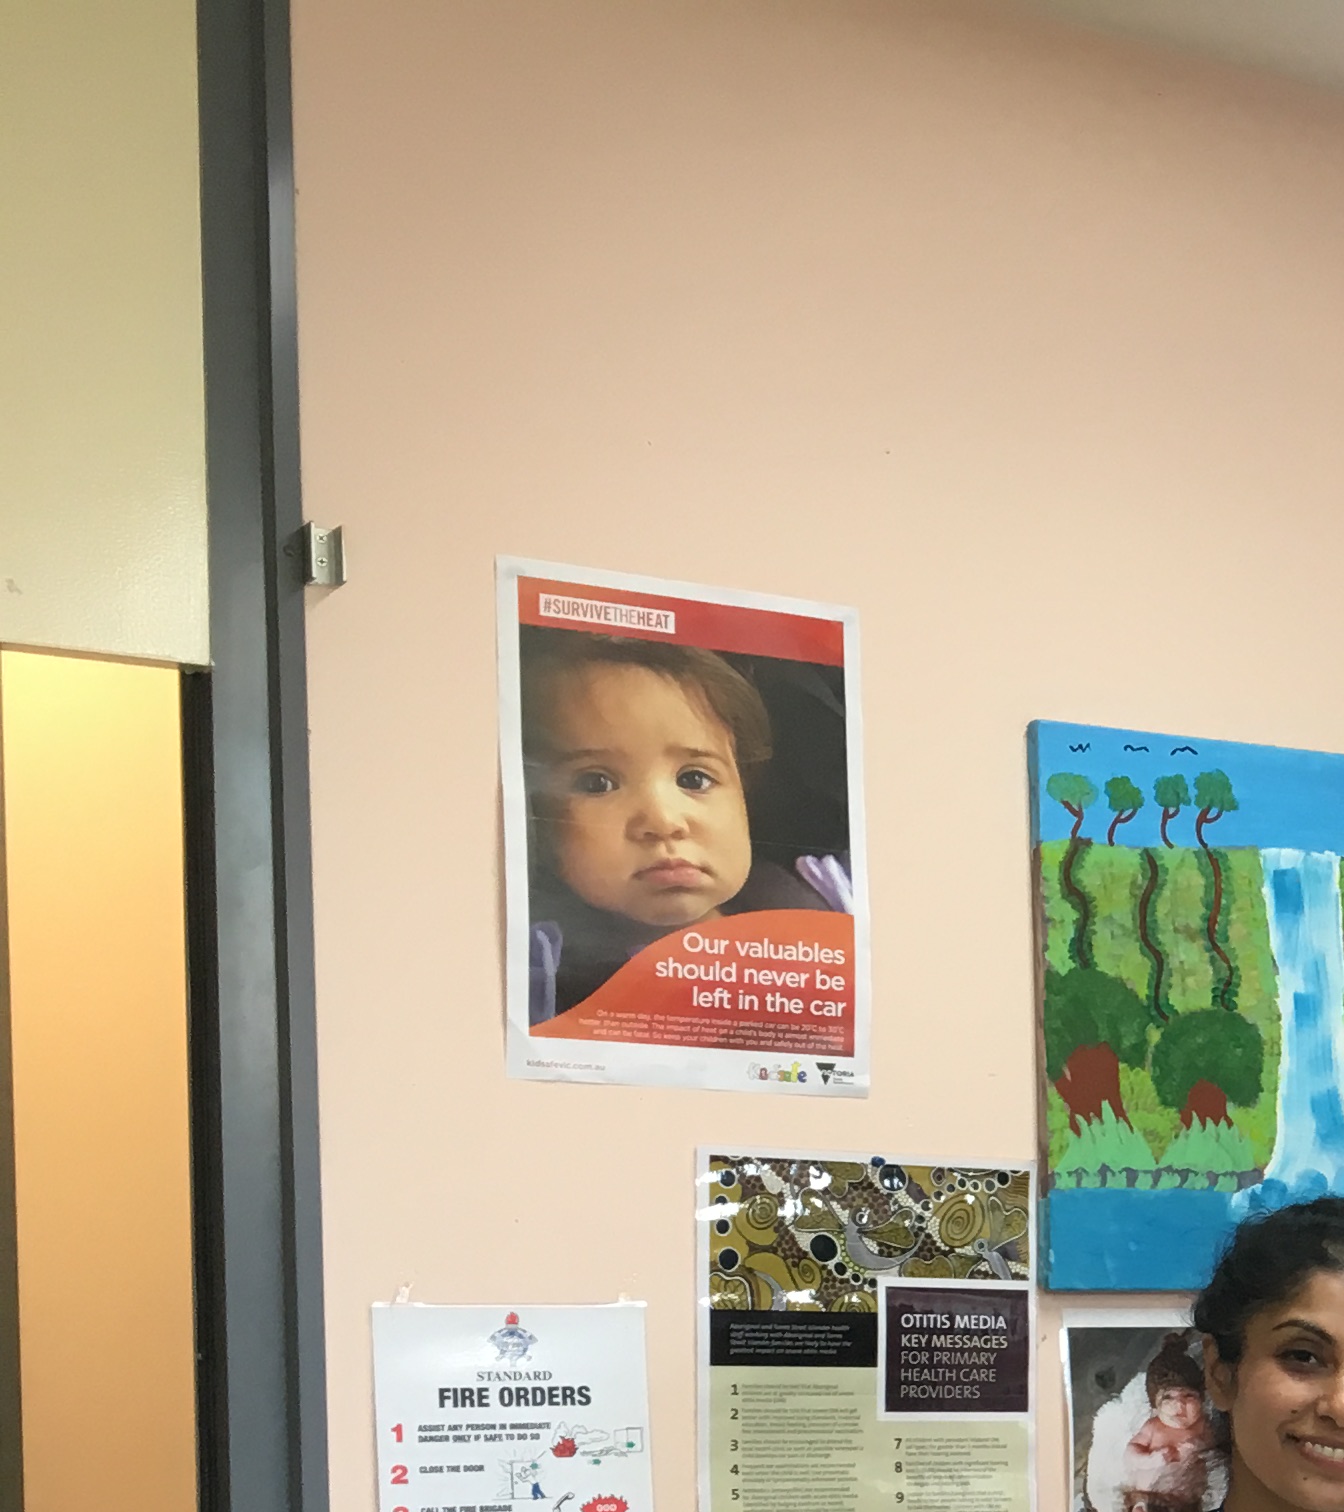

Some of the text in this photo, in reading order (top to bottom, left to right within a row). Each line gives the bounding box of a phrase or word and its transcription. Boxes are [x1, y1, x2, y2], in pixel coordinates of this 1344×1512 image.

[543, 598, 670, 630] #SURVIVETHEHEAT
[682, 932, 846, 965] Our valuables
[655, 957, 846, 991] should never be
[692, 986, 847, 1018] left in the car
[901, 1313, 1007, 1330] OTITIS MEDIA
[901, 1335, 1008, 1349] KEY MESSAGES
[901, 1351, 997, 1365] FOR PRIMARY
[476, 1370, 552, 1382] STANDARD
[900, 1368, 996, 1382] HEALTH CARE
[438, 1386, 592, 1408] FIRE ORDERS
[730, 1384, 739, 1396] 1
[900, 1384, 981, 1399] PROVIDERS
[730, 1408, 739, 1420] 2
[391, 1423, 403, 1443] 1
[730, 1439, 739, 1451] 3
[894, 1438, 902, 1449] 7
[730, 1464, 740, 1475] 4
[894, 1461, 903, 1473] 8
[390, 1465, 408, 1484] 2
[731, 1488, 740, 1500] 5
[895, 1492, 904, 1503] 9
